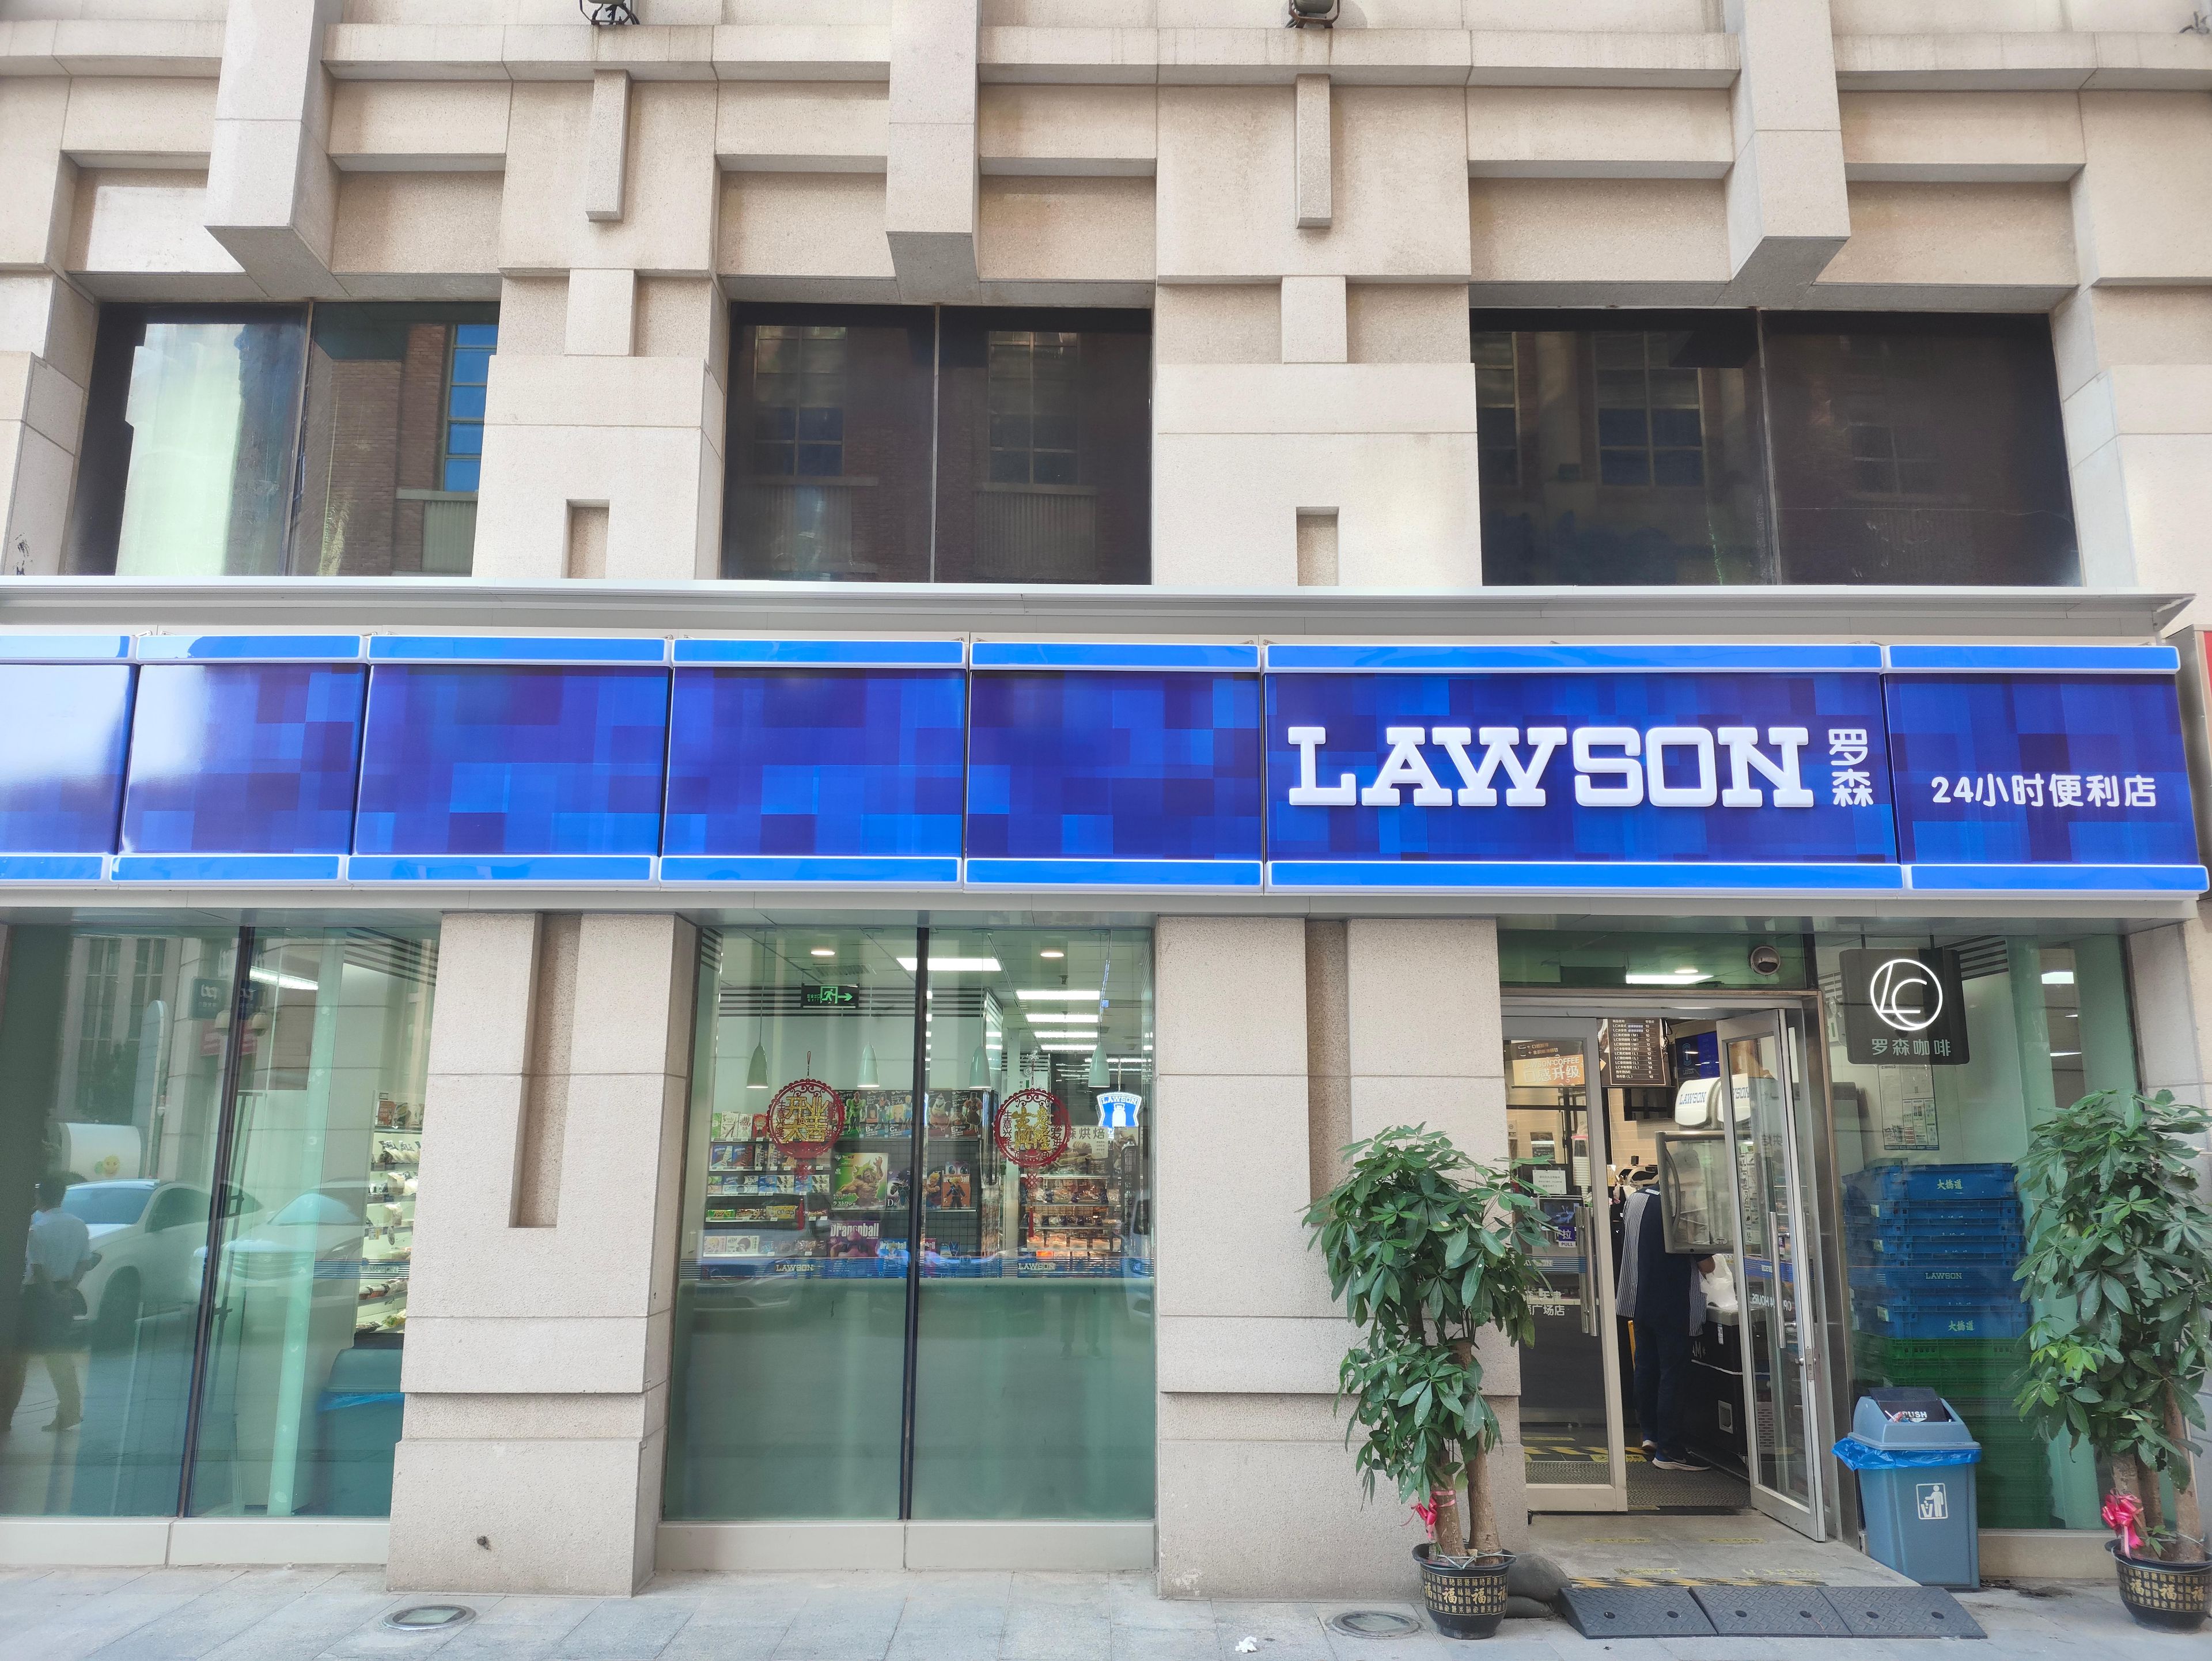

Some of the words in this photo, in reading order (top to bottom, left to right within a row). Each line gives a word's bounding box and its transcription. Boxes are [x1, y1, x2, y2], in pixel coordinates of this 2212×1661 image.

[1287, 727, 1814, 807] LAWSON
[1828, 728, 1874, 807] 罗森
[1930, 773, 2157, 808] 24小时便利店
[1872, 1038, 1951, 1057] 罗森咖啡
[1524, 1060, 1552, 1070] LAWSON
[1554, 1057, 1580, 1066] COFFEE
[1524, 1065, 1581, 1083] 口感升级
[1101, 1096, 1138, 1106] LAWSON
[1679, 1091, 1707, 1106] LAWSON
[1070, 1127, 1105, 1140] 森烘焙
[1562, 1229, 1572, 1240] 拉
[1018, 1262, 1055, 1270] LAWSON
[1442, 1587, 1457, 1605] 福
[1471, 1587, 1487, 1605] 福
[2159, 1583, 2177, 1601] 福
